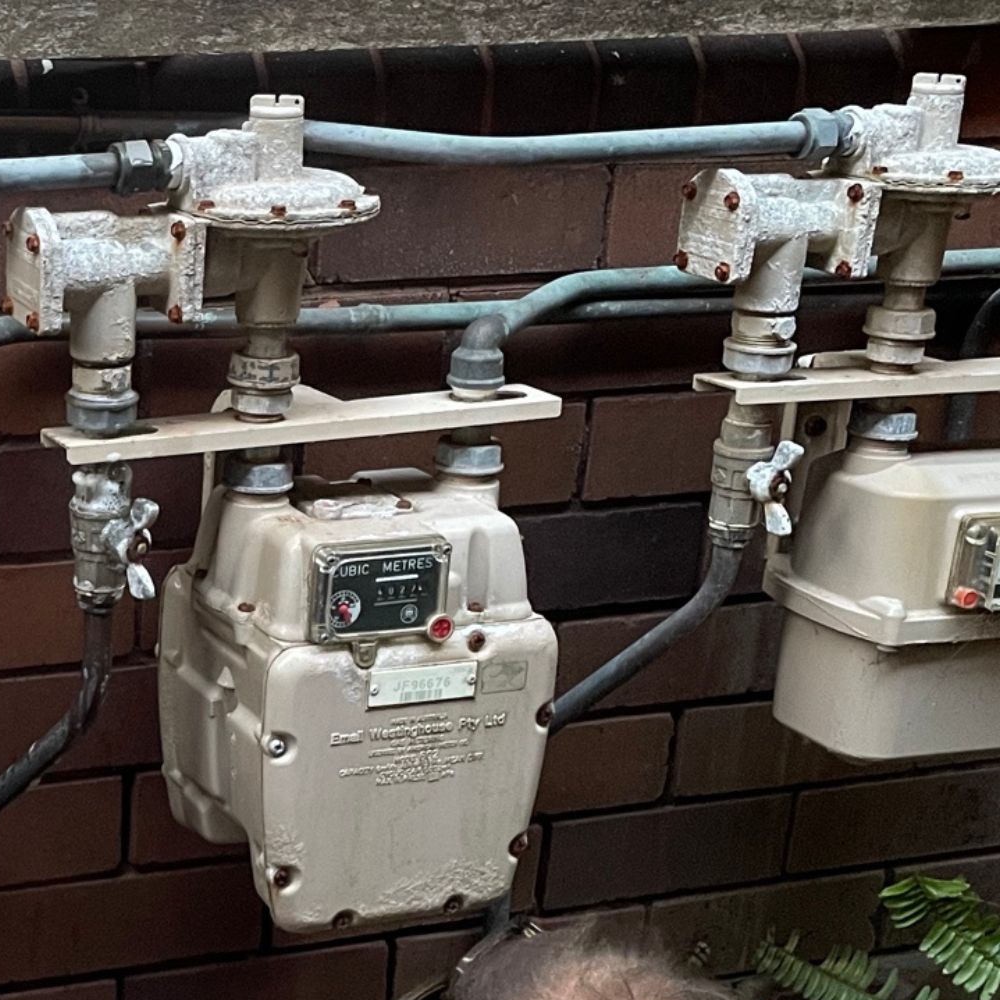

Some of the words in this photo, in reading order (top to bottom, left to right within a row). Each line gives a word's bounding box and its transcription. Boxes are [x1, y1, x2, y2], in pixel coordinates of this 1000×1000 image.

[382, 557, 433, 573] METRES
[369, 720, 453, 742] Westinghouse
[458, 716, 481, 732] Pty
[484, 712, 506, 729] Ltd
